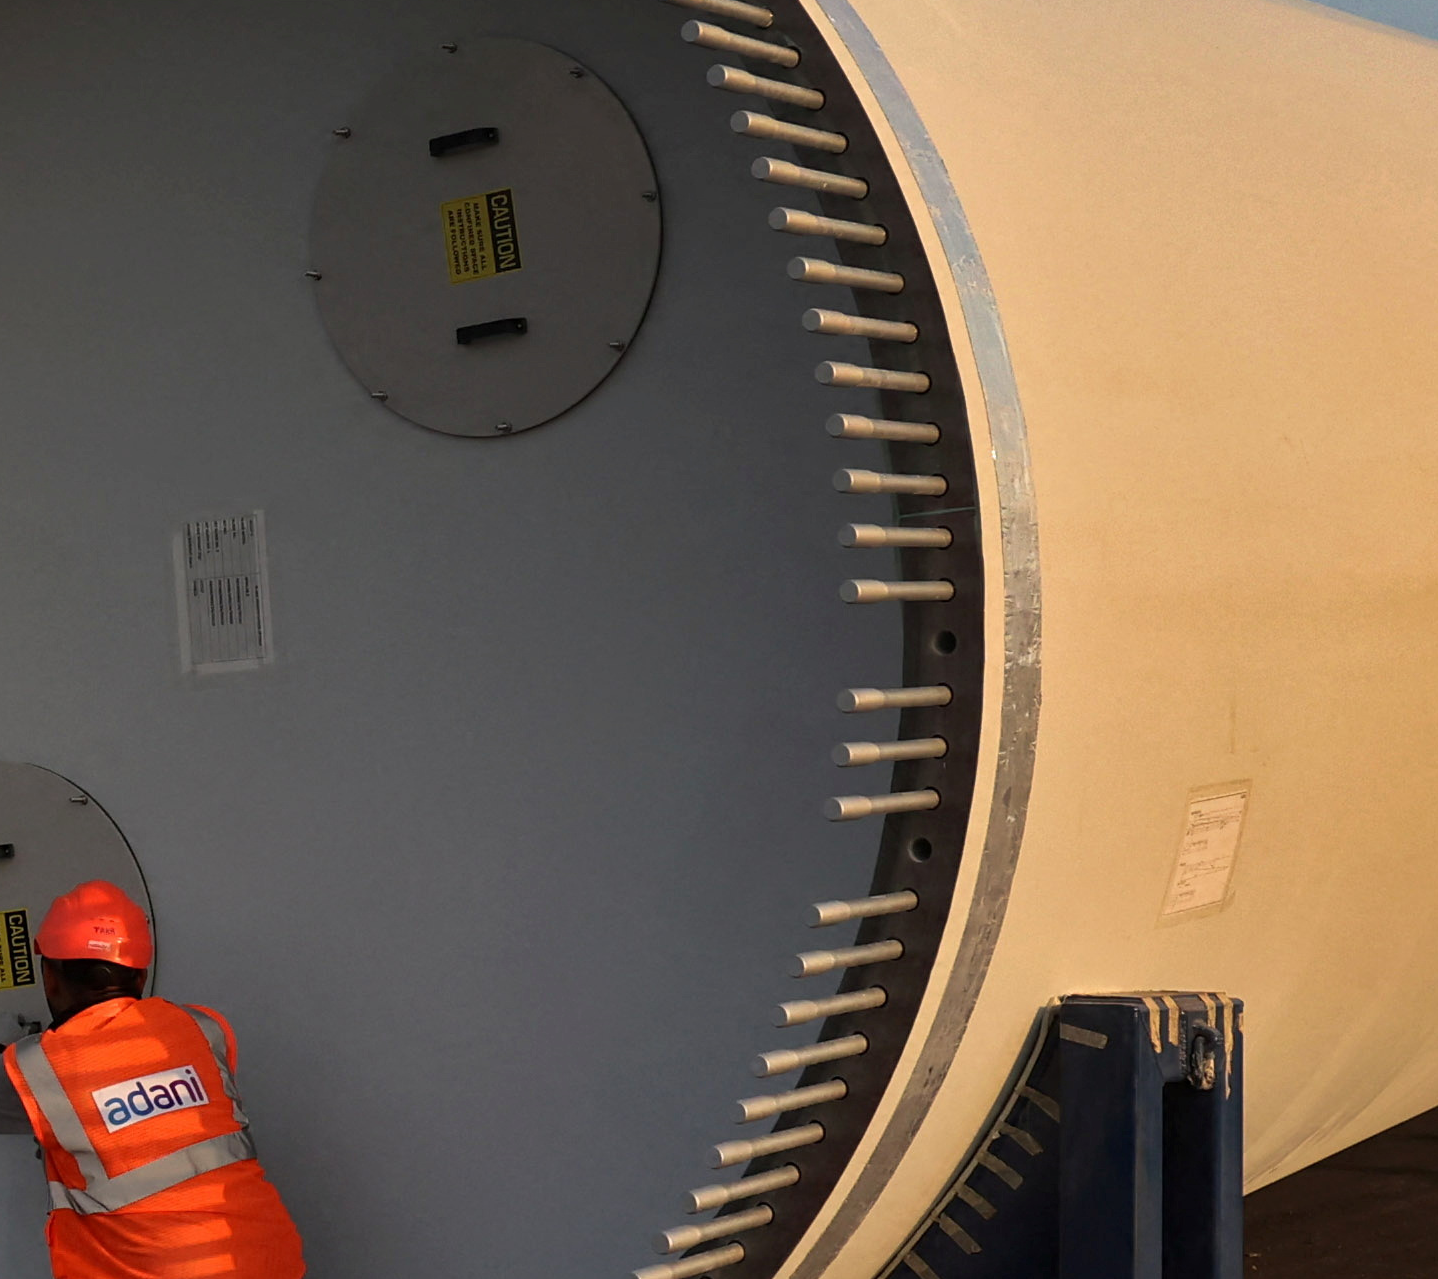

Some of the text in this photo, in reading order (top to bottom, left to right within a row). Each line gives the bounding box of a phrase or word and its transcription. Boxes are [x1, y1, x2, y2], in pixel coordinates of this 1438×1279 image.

[457, 209, 470, 273] INSTRUCTIONS
[464, 202, 480, 275] CONFINED SPACE
[473, 202, 482, 227] MAKE
[476, 229, 485, 253] SURE
[490, 194, 516, 270] CAUTION
[450, 229, 461, 275] FOLLOWED
[8, 914, 30, 983] CAUTION
[104, 1068, 204, 1126] adani
